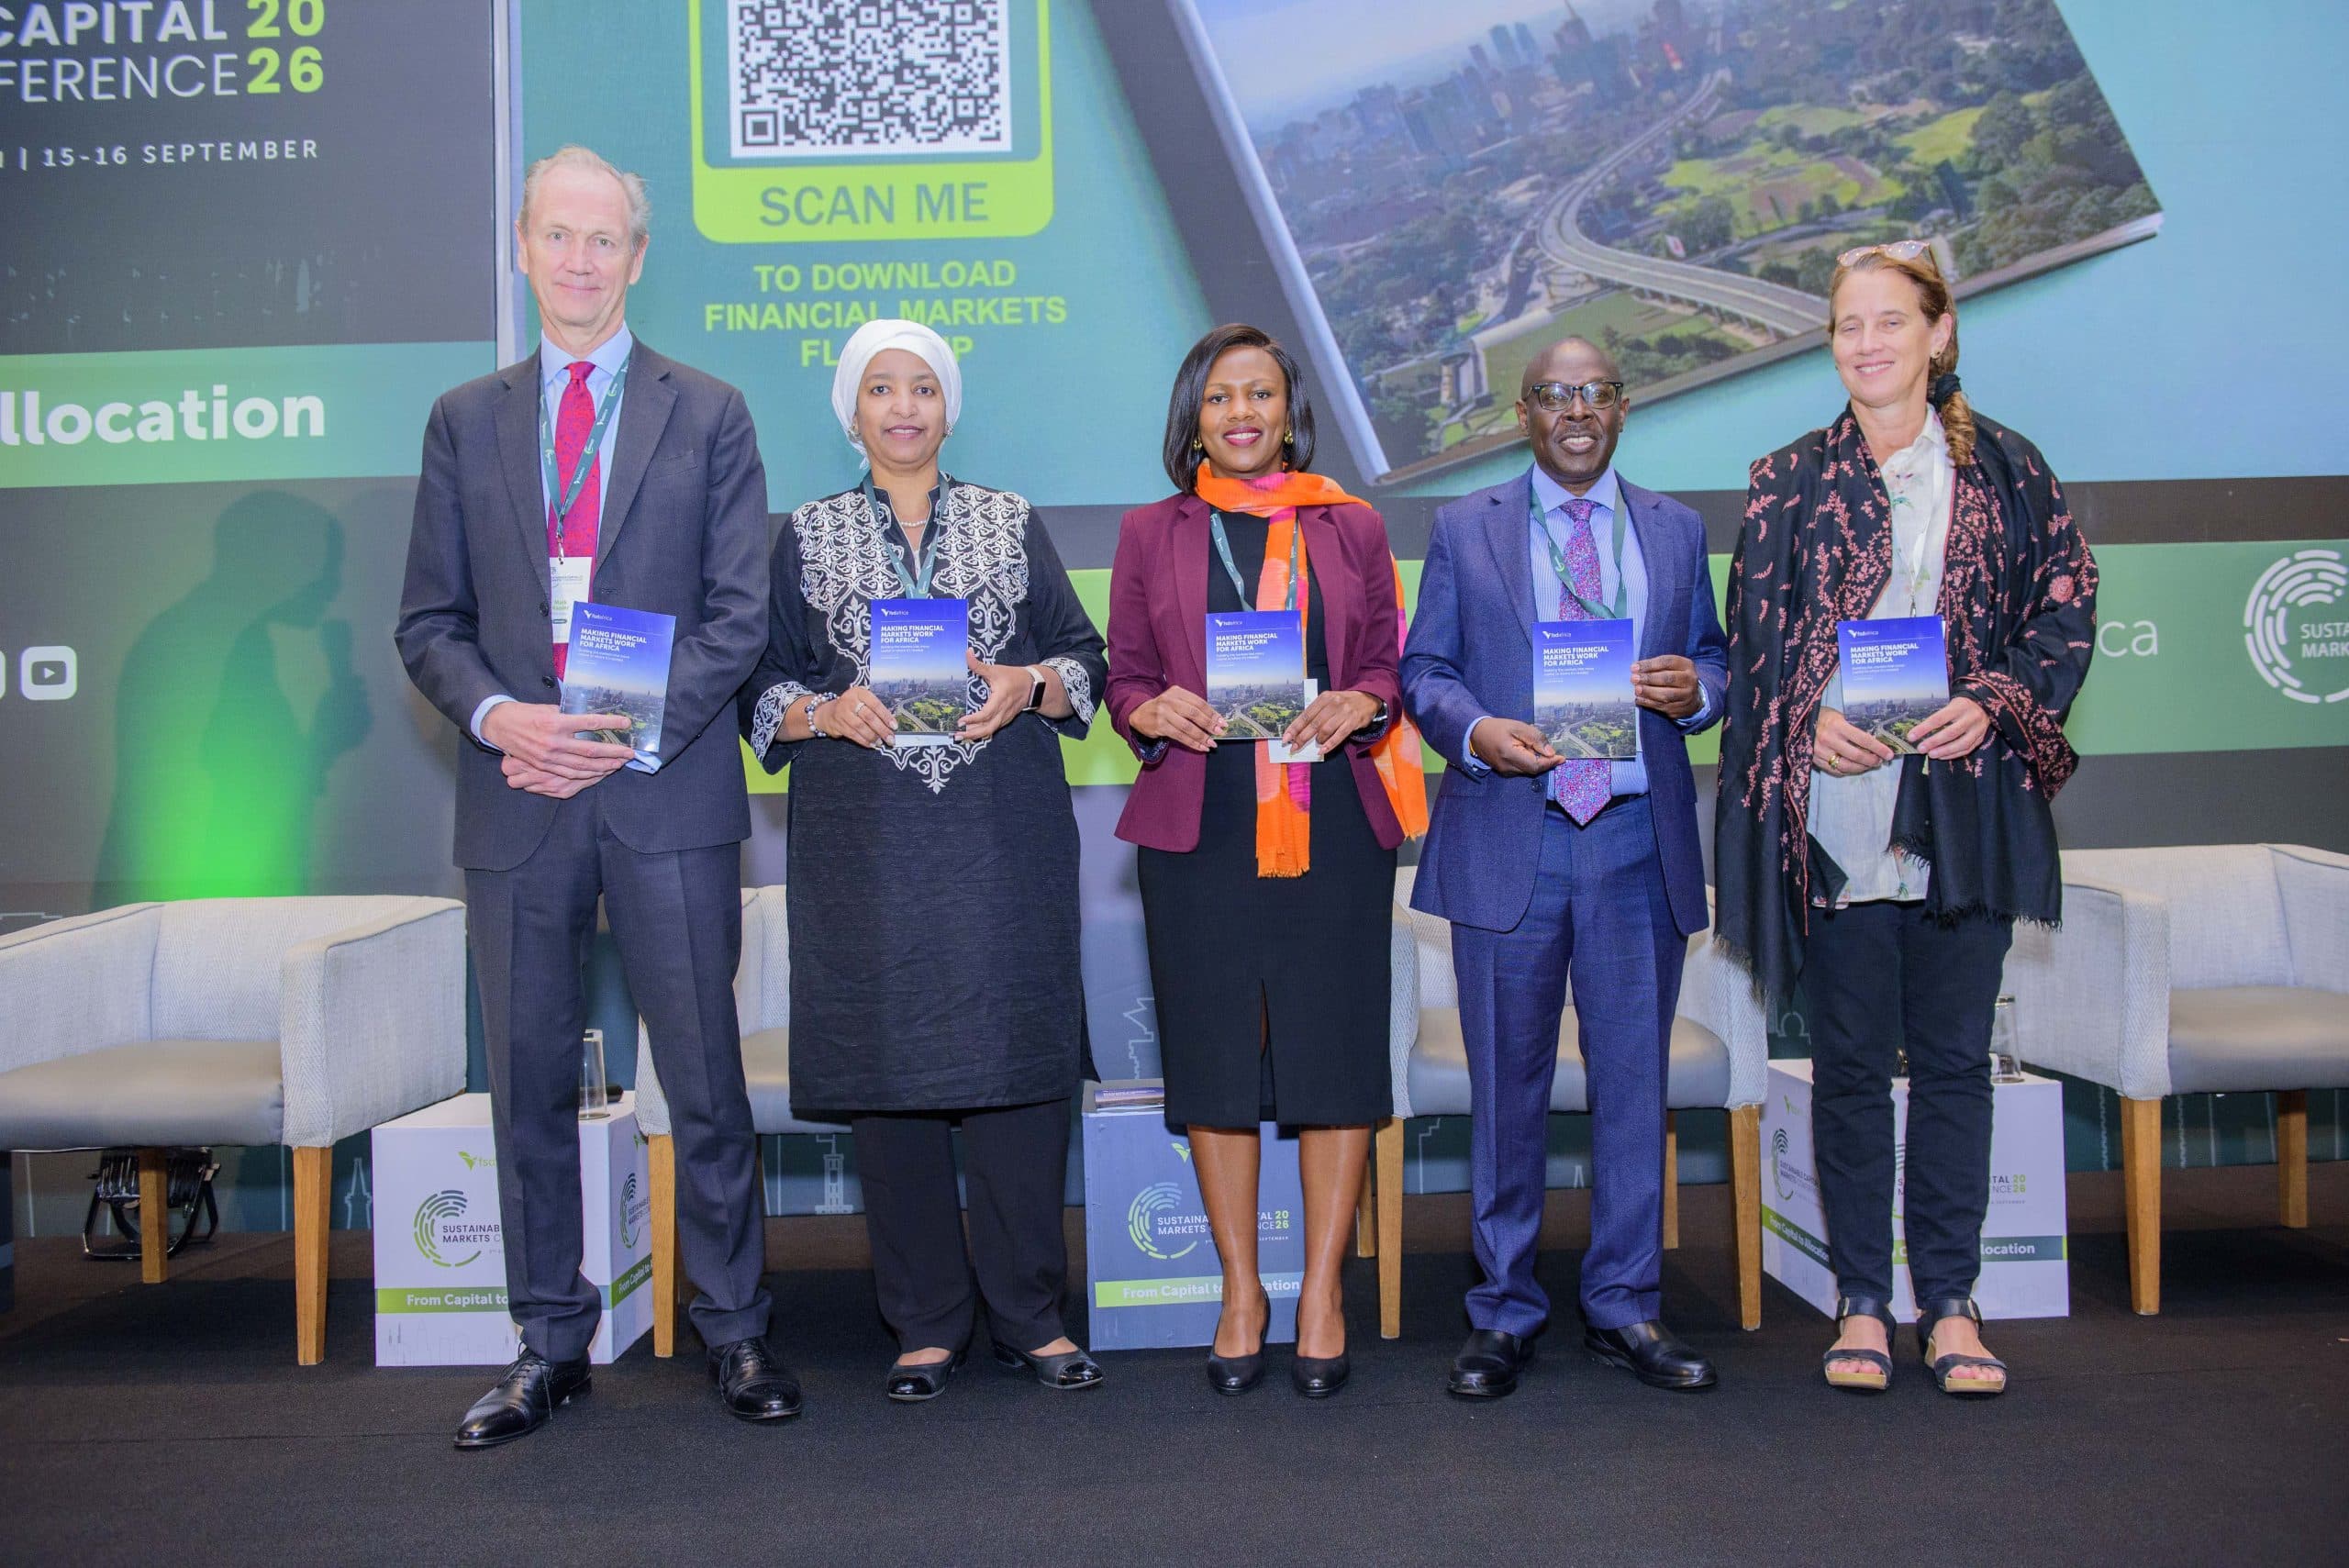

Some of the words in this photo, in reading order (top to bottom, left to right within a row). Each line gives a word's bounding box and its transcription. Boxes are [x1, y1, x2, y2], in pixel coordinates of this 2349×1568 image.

[246, 0, 326, 38] 20
[246, 46, 325, 94] 26
[42, 147, 128, 168] 15-16
[141, 139, 318, 164] SEPTEMBER
[759, 183, 896, 228] SCAN
[916, 183, 990, 223] ME
[753, 264, 802, 293] TO
[812, 260, 1016, 292] DOWNLOAD
[705, 301, 878, 332] FINANCIAL
[899, 295, 1067, 326] MARKETS
[0, 384, 325, 446] llocation
[580, 634, 613, 644] MARKETS
[614, 639, 636, 648] WORK
[581, 628, 610, 639] MAKING
[610, 632, 648, 644] FINANCIAL
[595, 642, 620, 651] AFRICA
[1850, 645, 1880, 653] MAKING
[1880, 642, 1920, 651] FINANCIAL
[1851, 651, 1885, 659] MARKETS
[1866, 656, 1894, 664] AFRICA
[2012, 1173, 2026, 1184] 20
[2012, 1184, 2026, 1194] 26
[1275, 1209, 1289, 1219] 20
[1157, 1225, 1207, 1236] MARKETS
[1275, 1219, 1290, 1229] 26
[442, 1234, 491, 1243] MARKETS
[1122, 1286, 1158, 1299] From
[1160, 1283, 1210, 1298] Capital
[406, 1294, 441, 1307] From
[443, 1293, 493, 1307] Capital
